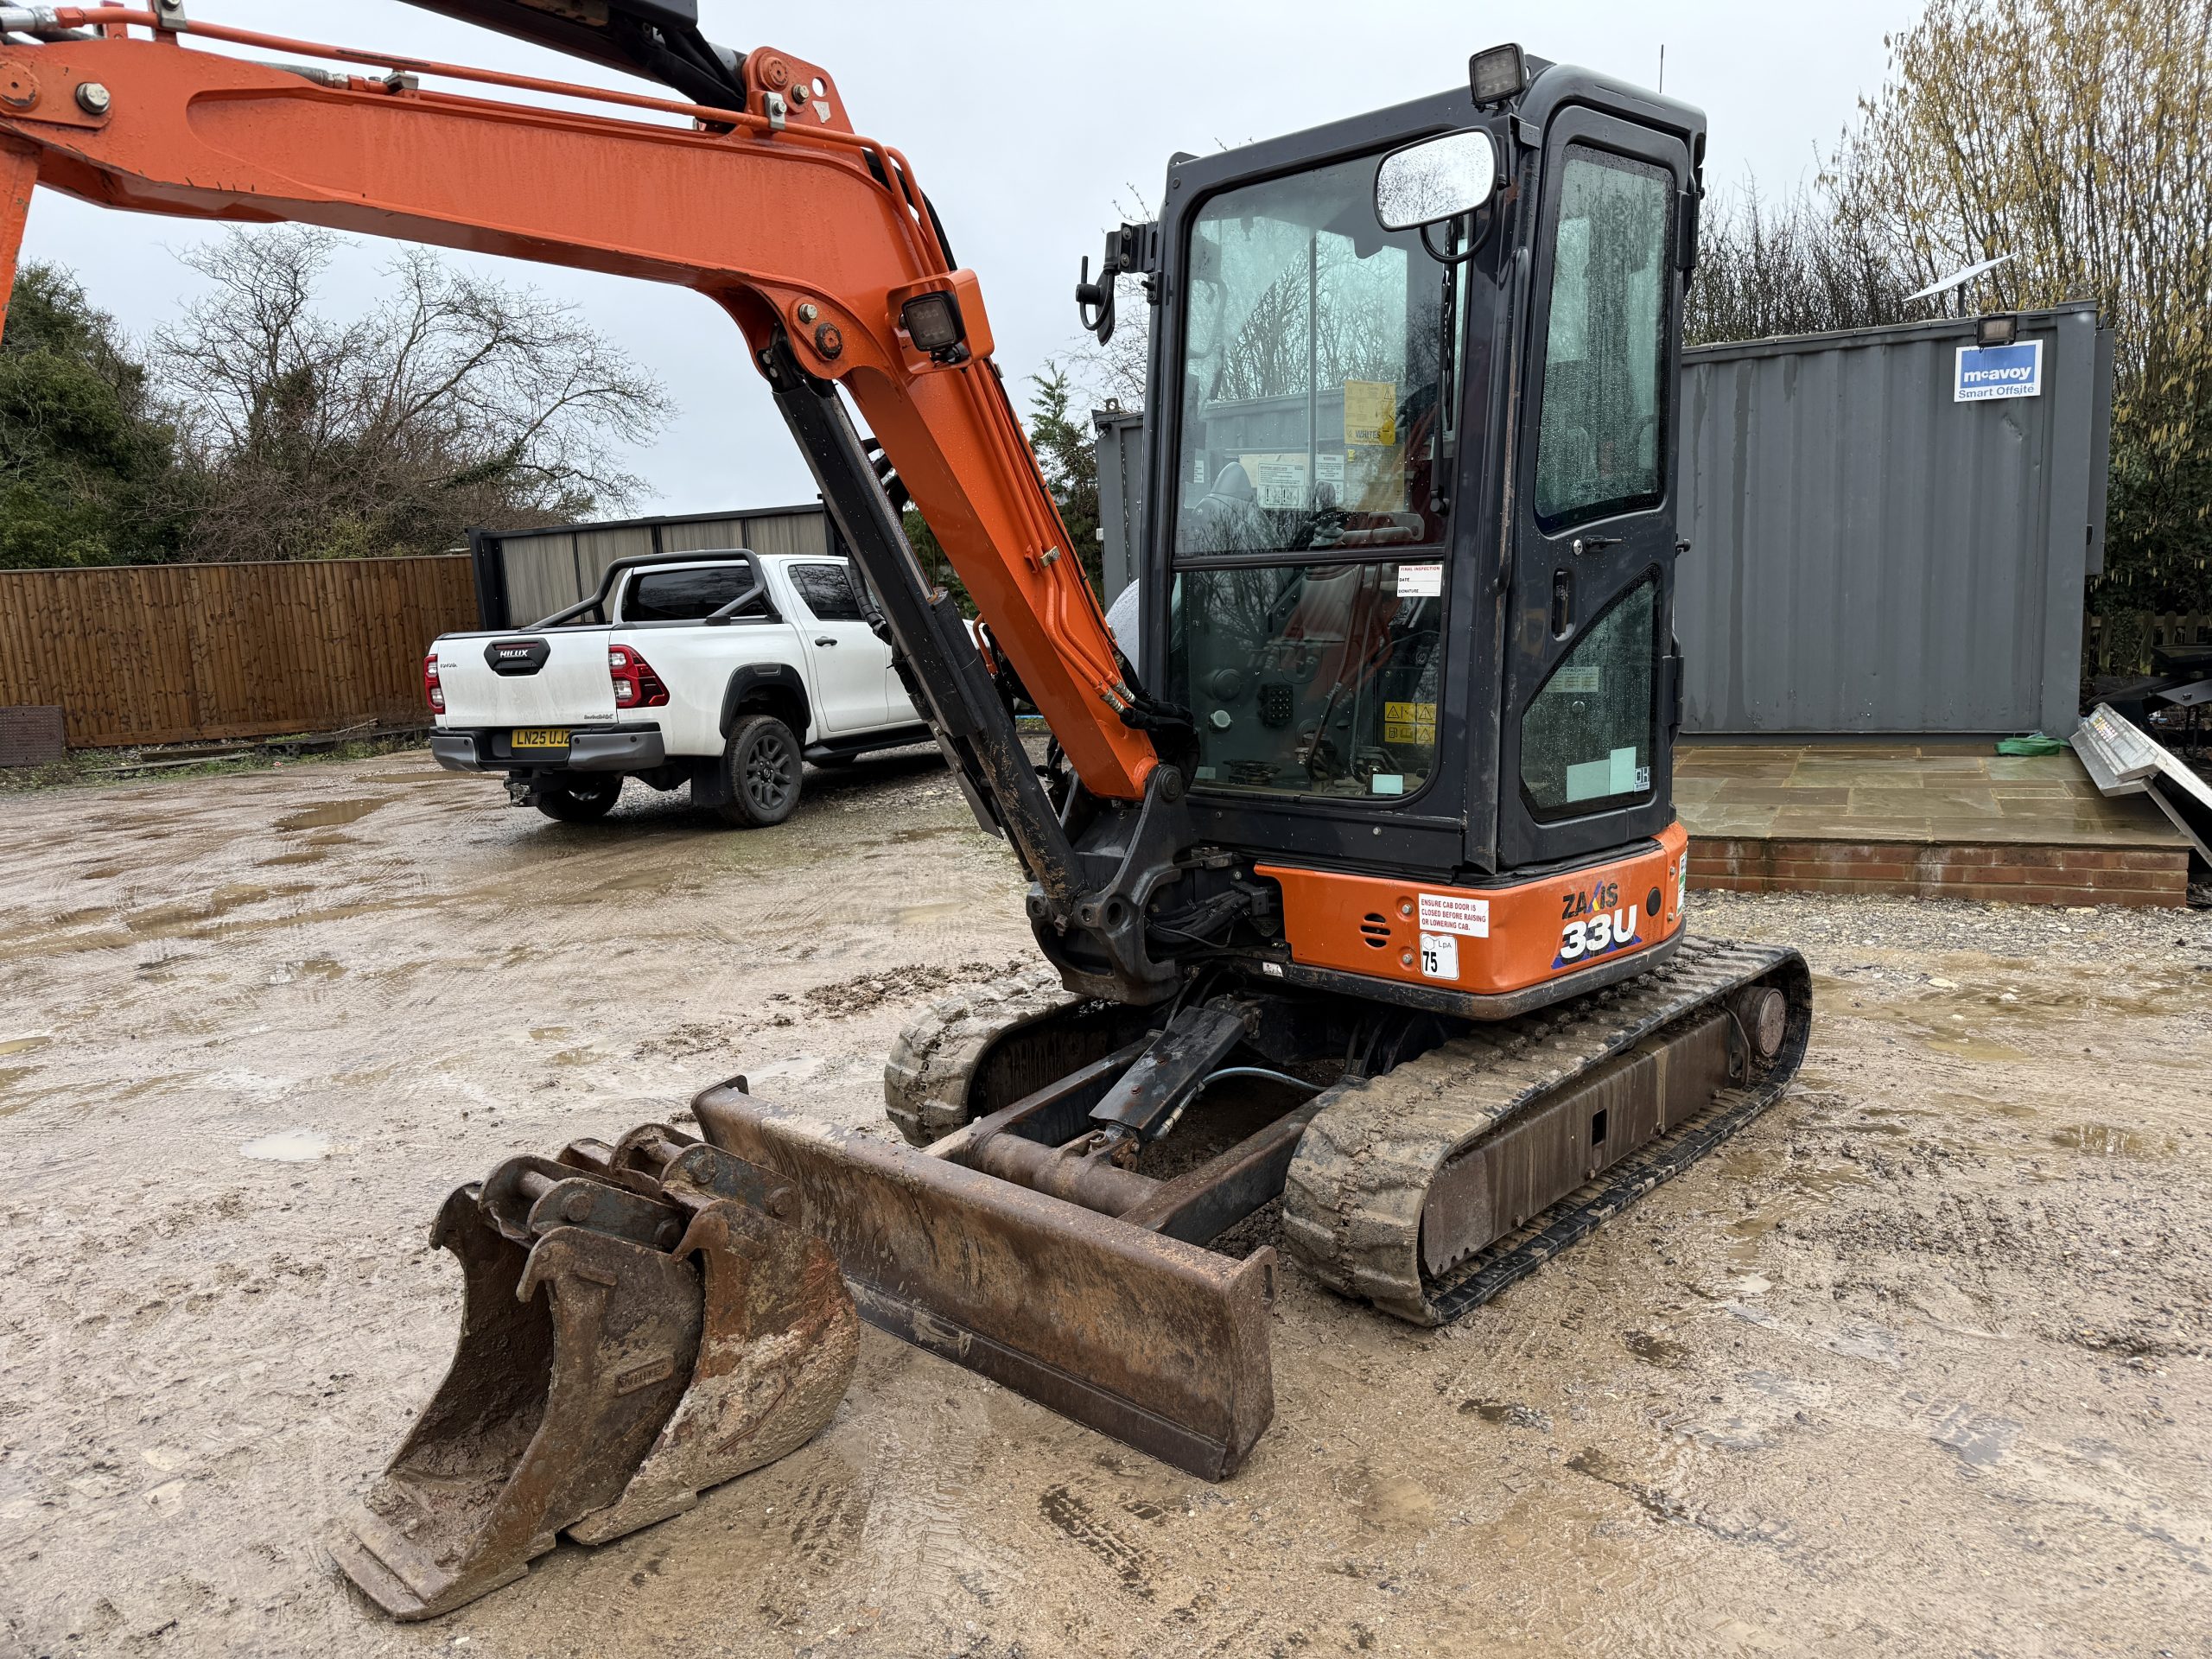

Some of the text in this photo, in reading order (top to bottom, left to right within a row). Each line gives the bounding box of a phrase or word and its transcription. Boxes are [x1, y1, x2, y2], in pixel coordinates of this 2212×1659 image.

[1963, 366, 2032, 383] mcavoy
[1958, 385, 2035, 399] Smart Offsite
[499, 649, 529, 658] HILUX
[517, 730, 546, 745] LN25
[1421, 899, 1442, 907] ENSURE
[1454, 902, 1470, 911] DOOR
[1561, 880, 1618, 920] ZAXIS
[1421, 908, 1486, 922] CLOSED BEFORE RAISING
[1429, 918, 1457, 929] LOWERING
[1560, 904, 1638, 962] 33U
[1422, 950, 1438, 973] 75
